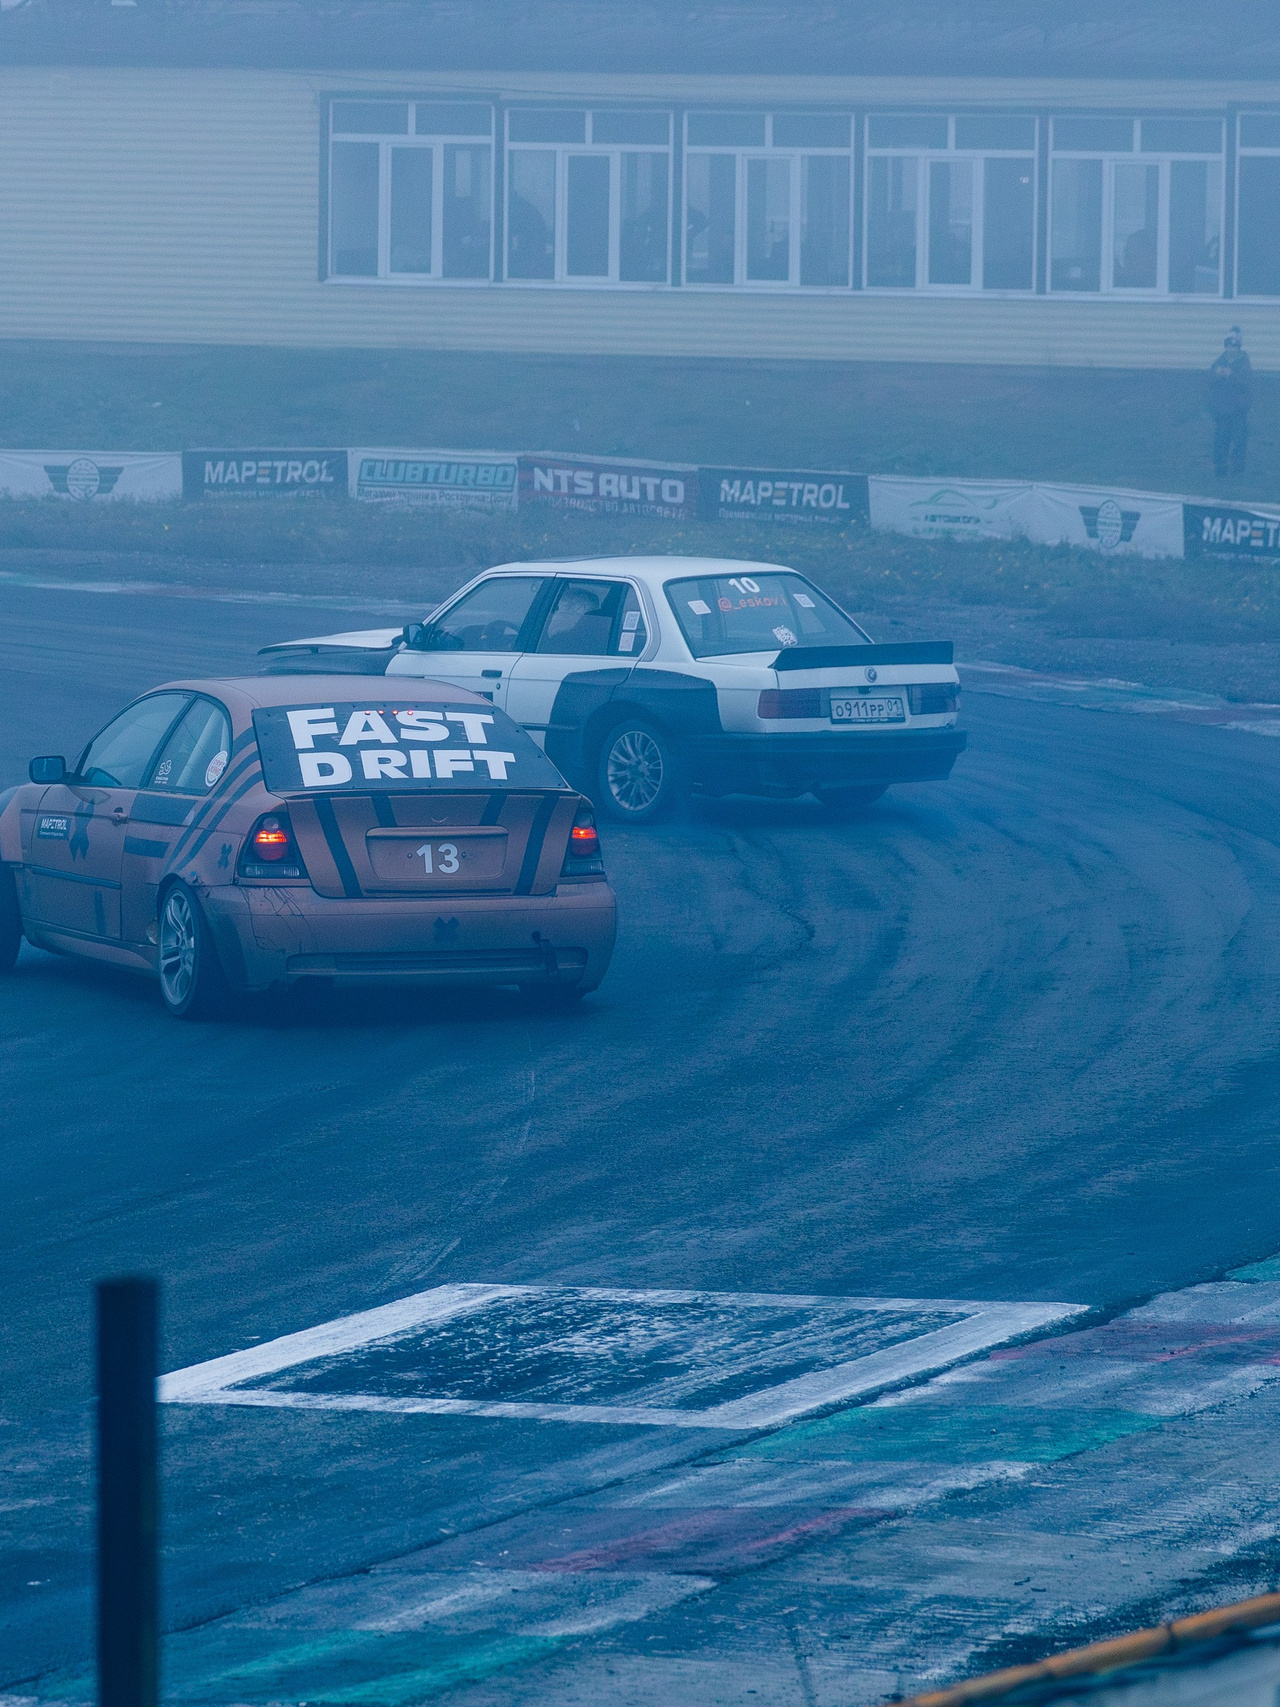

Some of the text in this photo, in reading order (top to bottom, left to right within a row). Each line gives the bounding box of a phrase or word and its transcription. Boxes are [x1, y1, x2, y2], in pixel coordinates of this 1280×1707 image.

[204, 460, 334, 484] MAPETROL
[360, 461, 516, 488] CLUBTURBO
[533, 467, 685, 504] NTS AUTO
[720, 479, 850, 509] MAPETROL
[1202, 516, 1280, 549] MAPET
[728, 577, 761, 594] 10
[286, 708, 495, 750] FAST
[298, 750, 516, 787] DRIFT
[416, 843, 460, 874] 13
